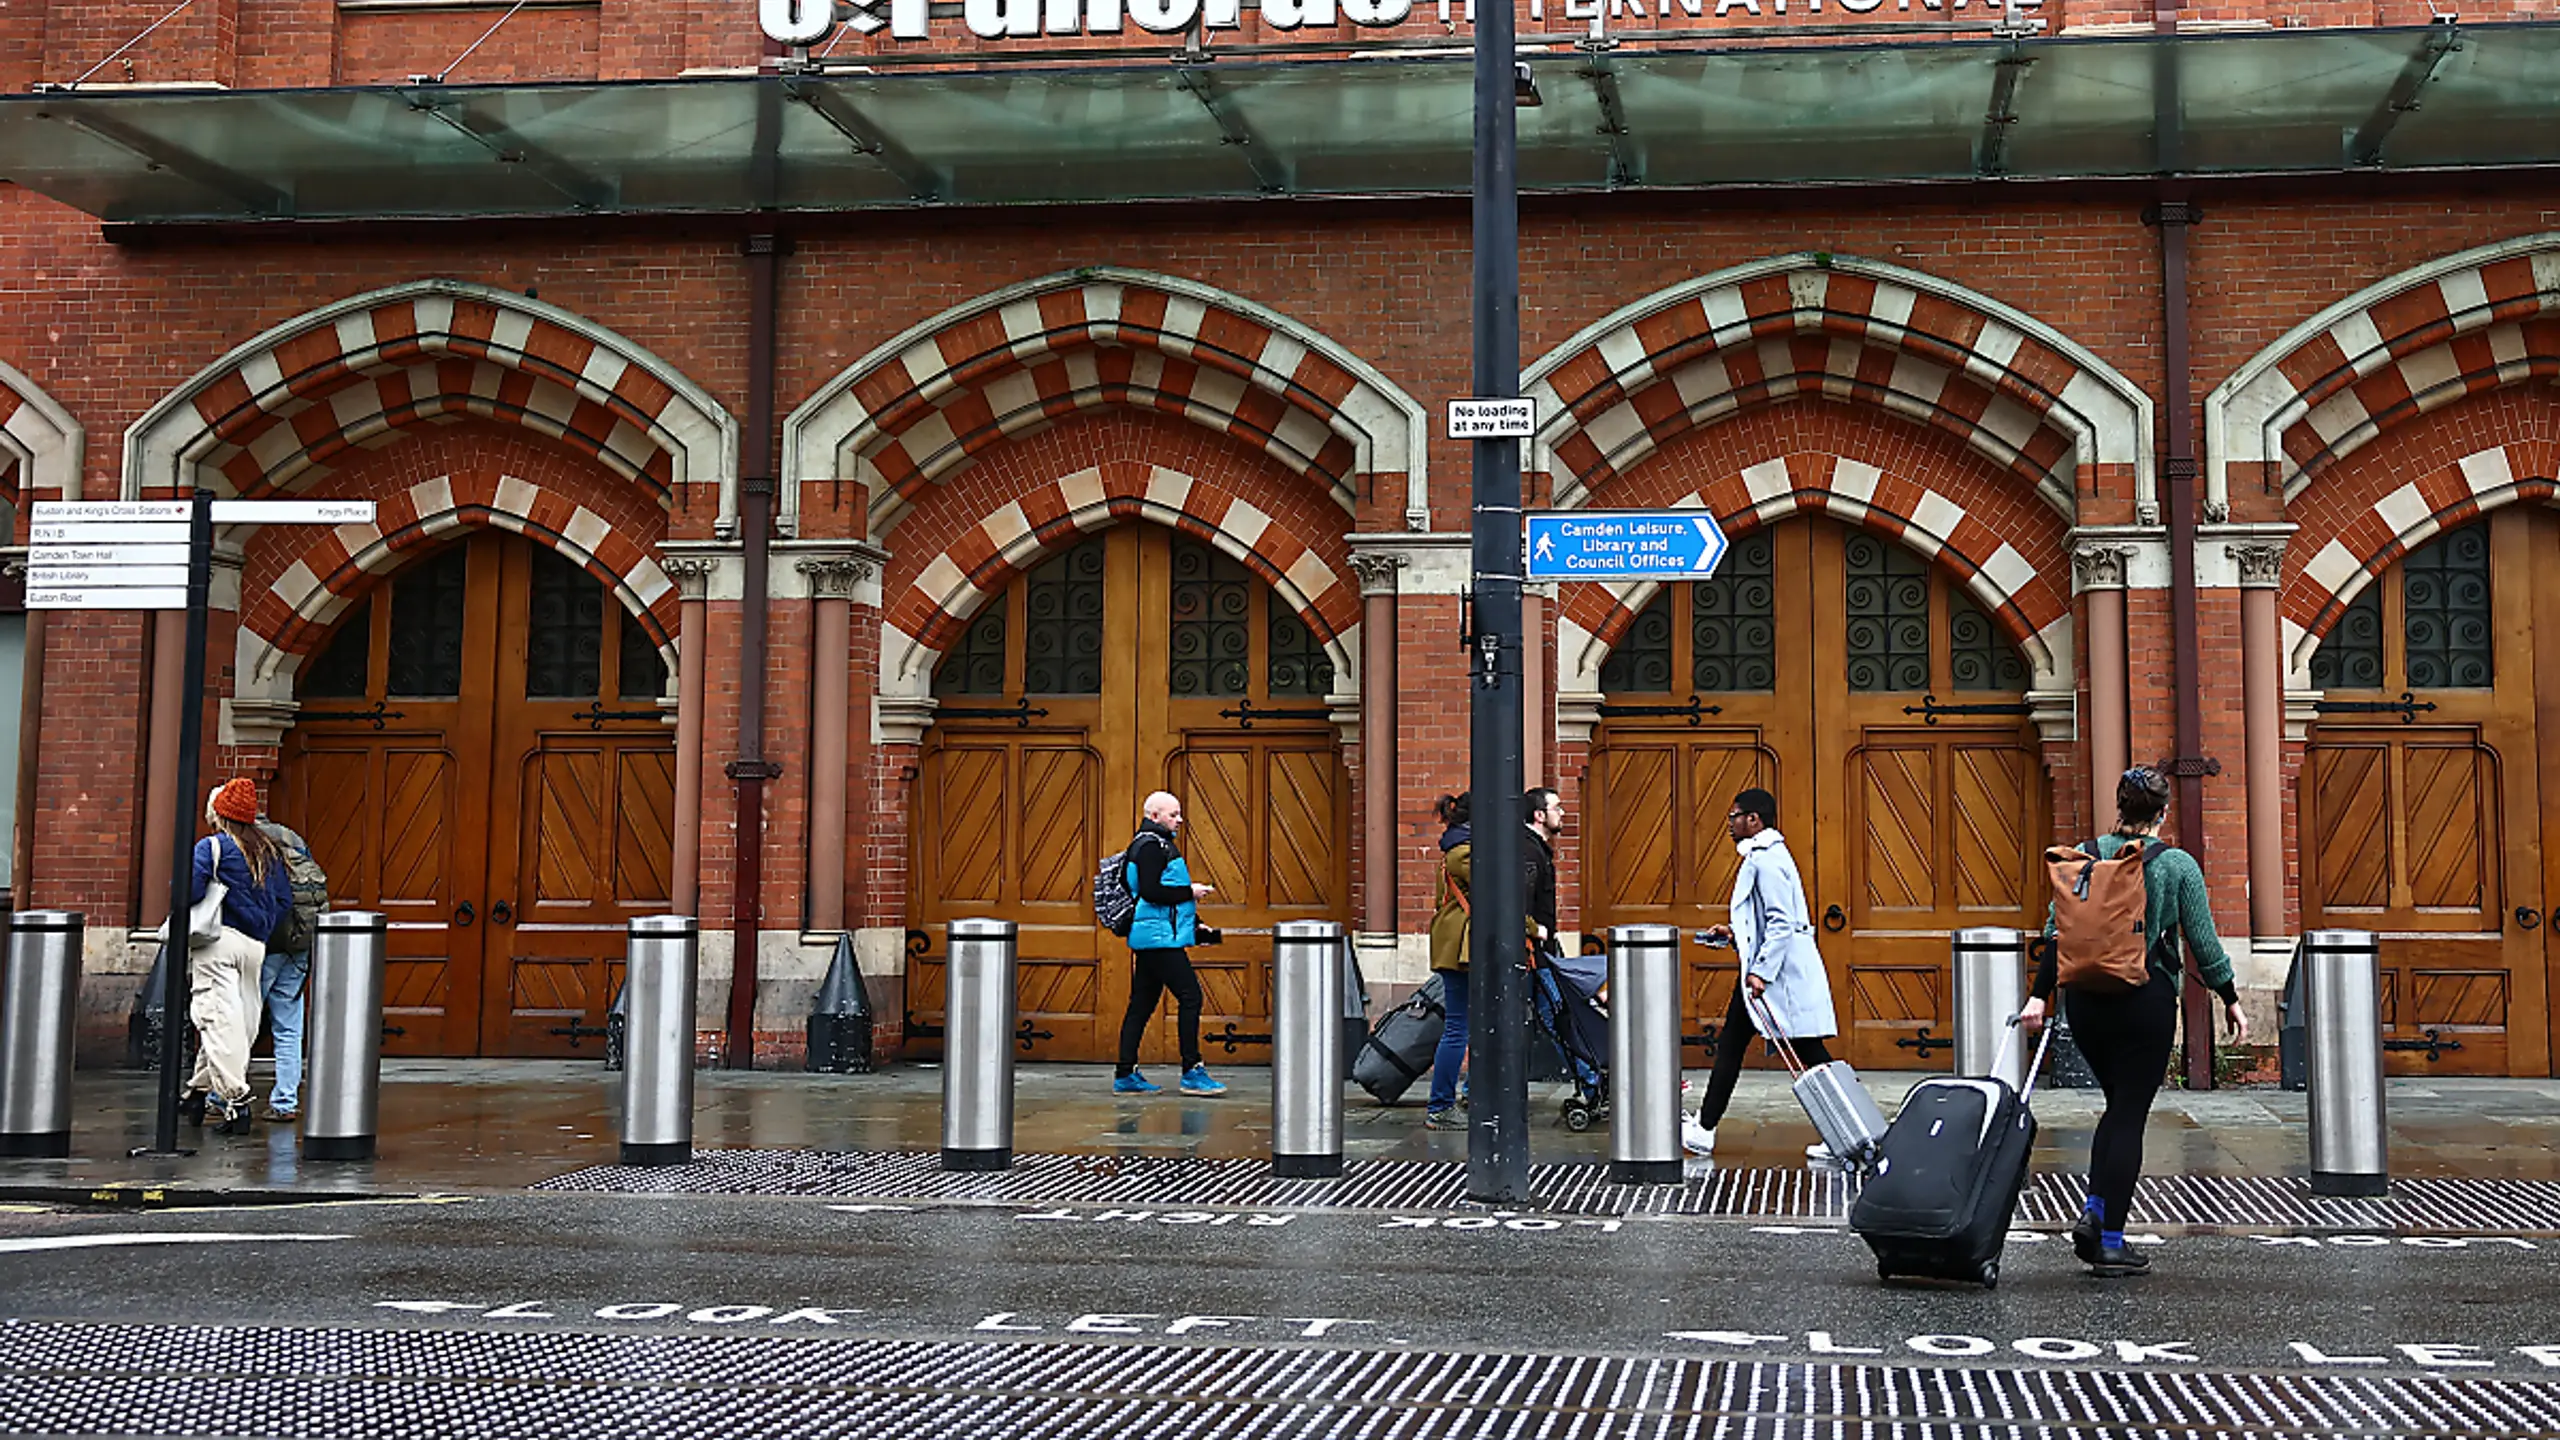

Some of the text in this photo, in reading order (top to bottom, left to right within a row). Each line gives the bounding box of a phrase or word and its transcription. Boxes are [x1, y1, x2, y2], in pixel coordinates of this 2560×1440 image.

[1455, 405, 1528, 420] No loading
[1453, 419, 1529, 433] at any time
[36, 506, 65, 516] Euston
[66, 506, 82, 515] and
[111, 505, 136, 515] Cross
[138, 505, 172, 515] Stations
[343, 508, 368, 517] Place
[1561, 522, 1688, 538] Camden Leisure,
[1582, 538, 1668, 554] Library and
[32, 550, 113, 560] Camden Town Hall
[1566, 553, 1685, 569] Council Offices
[31, 571, 90, 582] British Library
[30, 593, 83, 602] Euston Road
[1013, 1208, 1624, 1232] LOOK RIGHT
[2249, 1235, 2540, 1250] LOOK
[482, 1302, 1380, 1337] LOOK LEFT
[1806, 1331, 2200, 1363] LOOK
